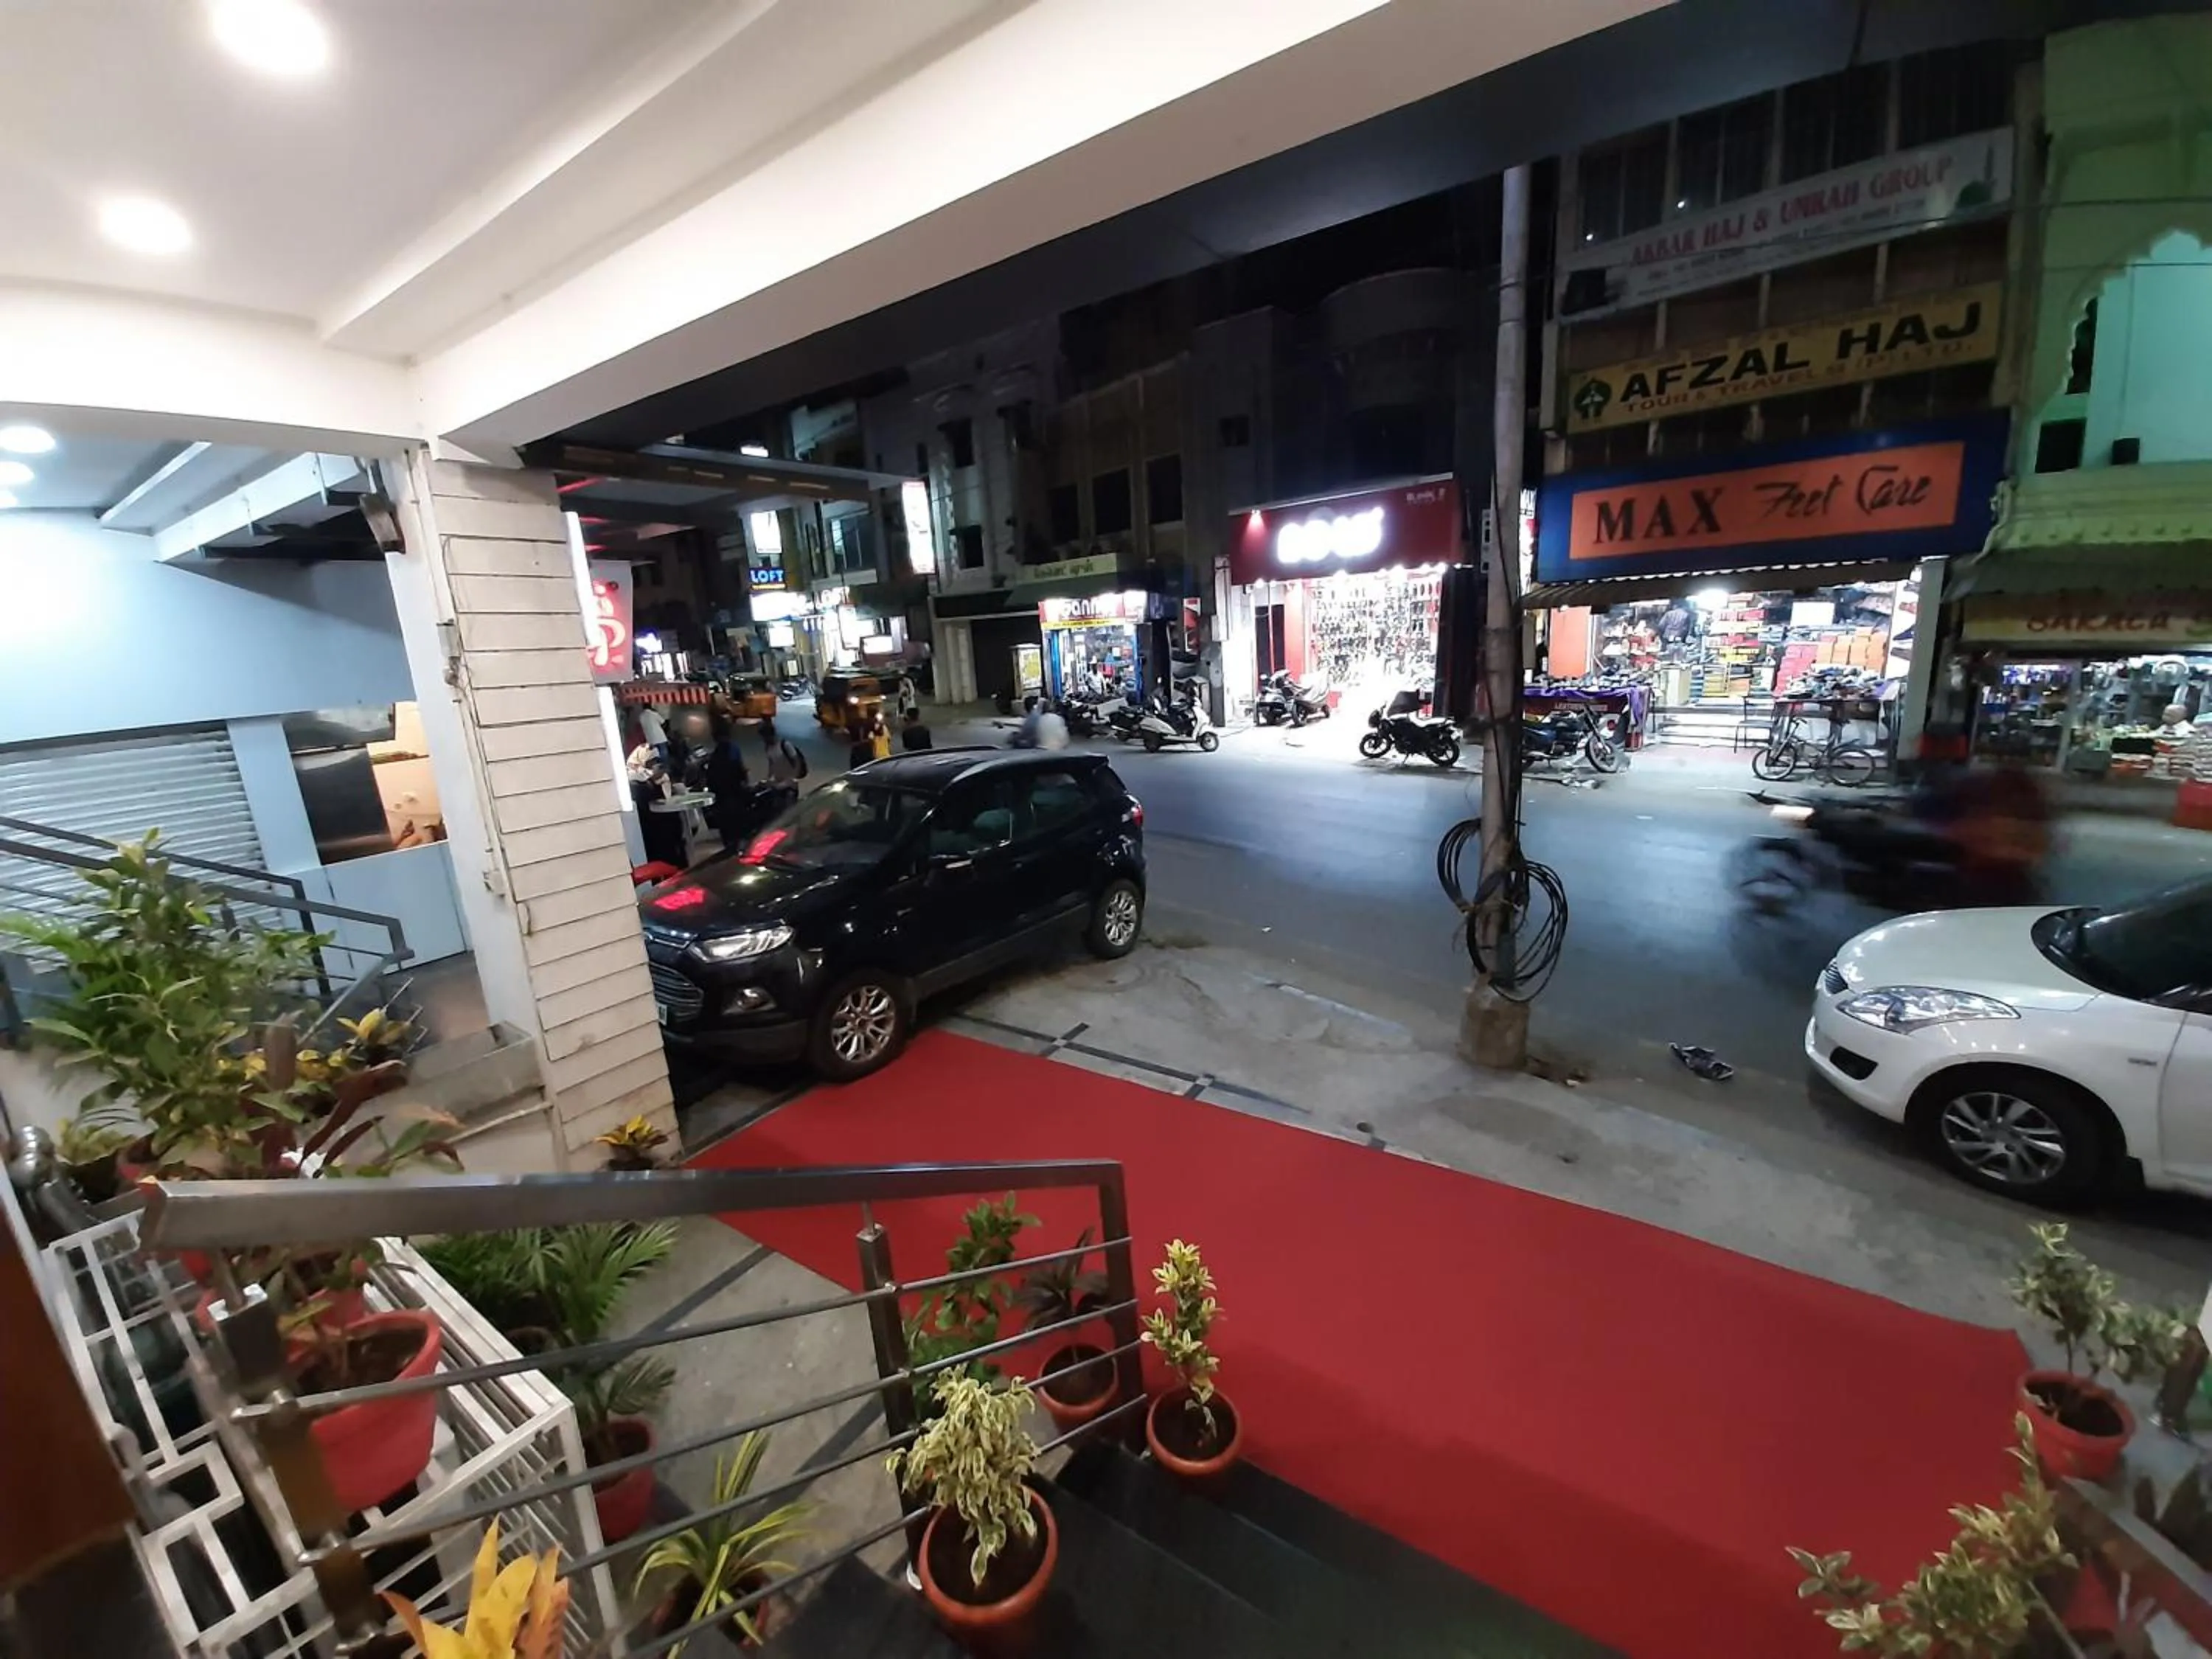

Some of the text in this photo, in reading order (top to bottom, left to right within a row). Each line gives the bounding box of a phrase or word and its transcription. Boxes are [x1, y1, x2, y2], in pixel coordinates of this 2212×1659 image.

[1703, 213, 1745, 249] HAJ
[1619, 302, 1981, 403] AFZAL HAJ
[1593, 488, 1723, 543] MAX
[750, 569, 785, 583] LOFT
